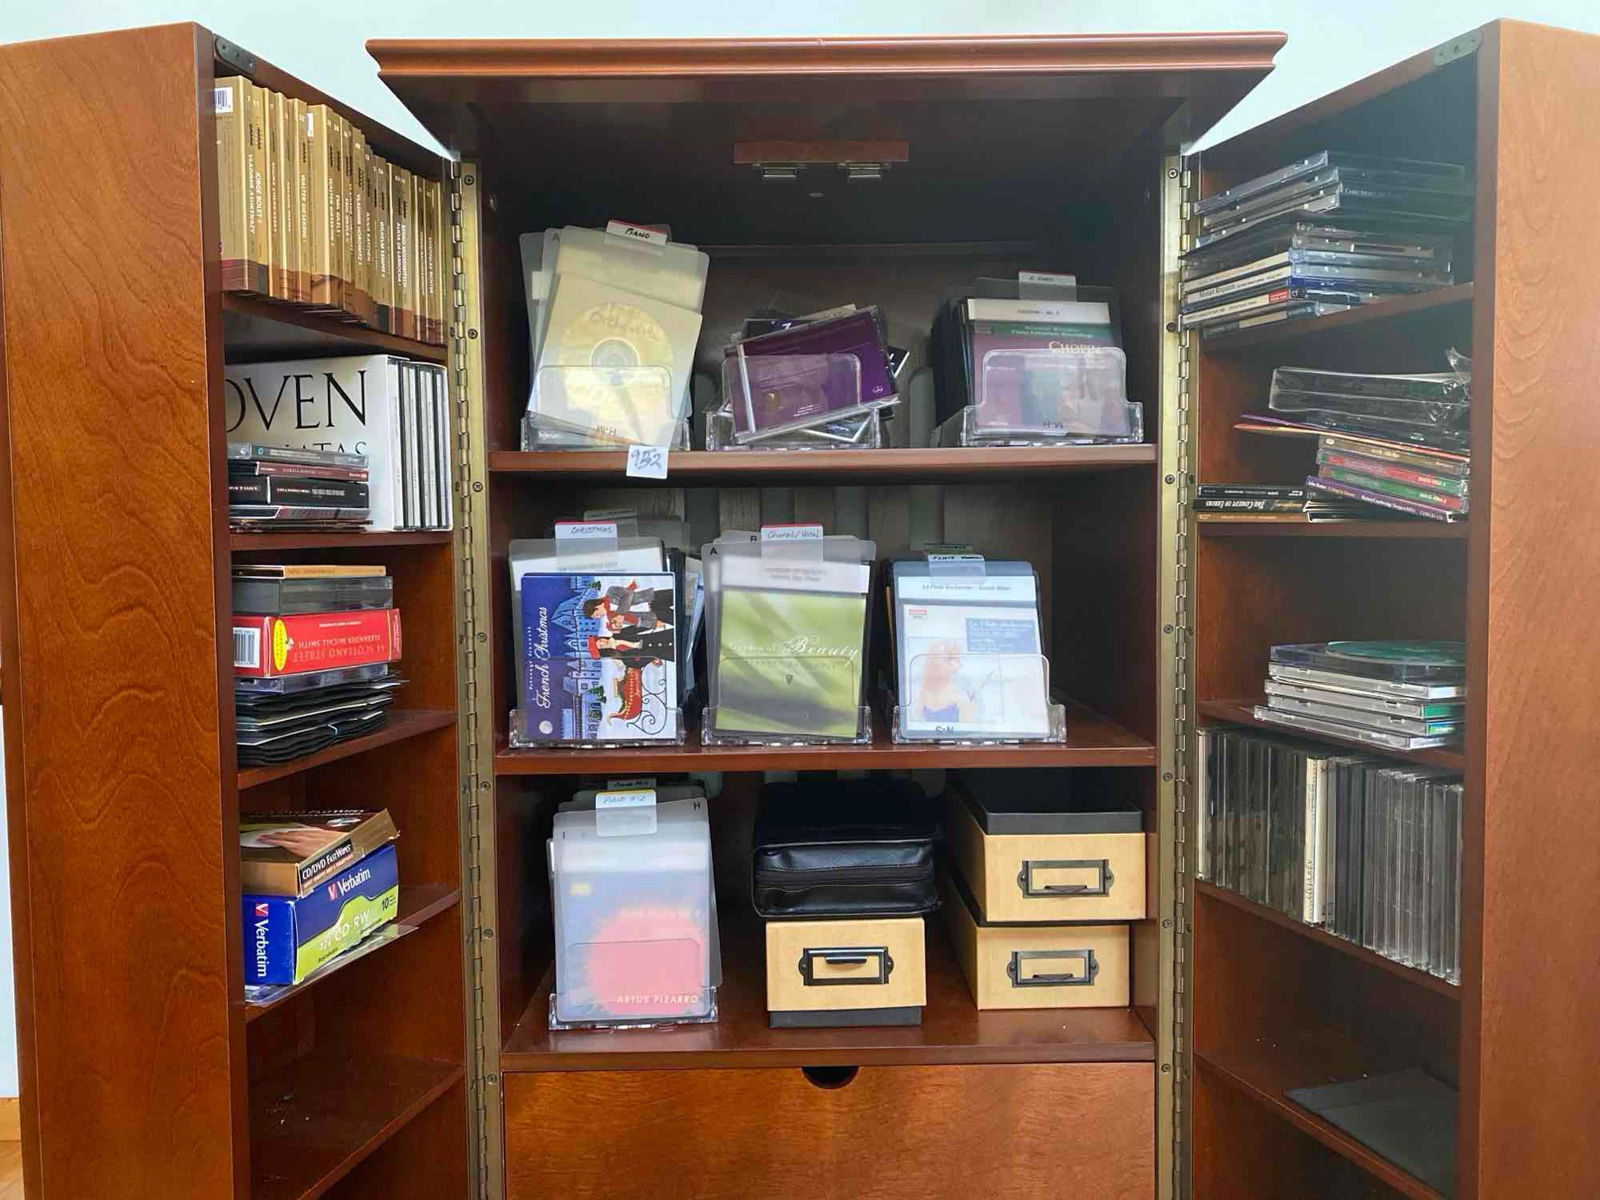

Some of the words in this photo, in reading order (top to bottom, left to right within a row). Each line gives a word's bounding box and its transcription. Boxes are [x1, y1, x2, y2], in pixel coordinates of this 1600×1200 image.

[298, 639, 321, 649] SMITH
[535, 606, 549, 661] Christmas
[293, 650, 325, 664] STREET
[785, 637, 859, 667] Beauty
[535, 662, 551, 709] French
[302, 858, 327, 880] CD/DVD
[337, 868, 371, 896] Verbatim
[253, 919, 270, 977] Verbatim
